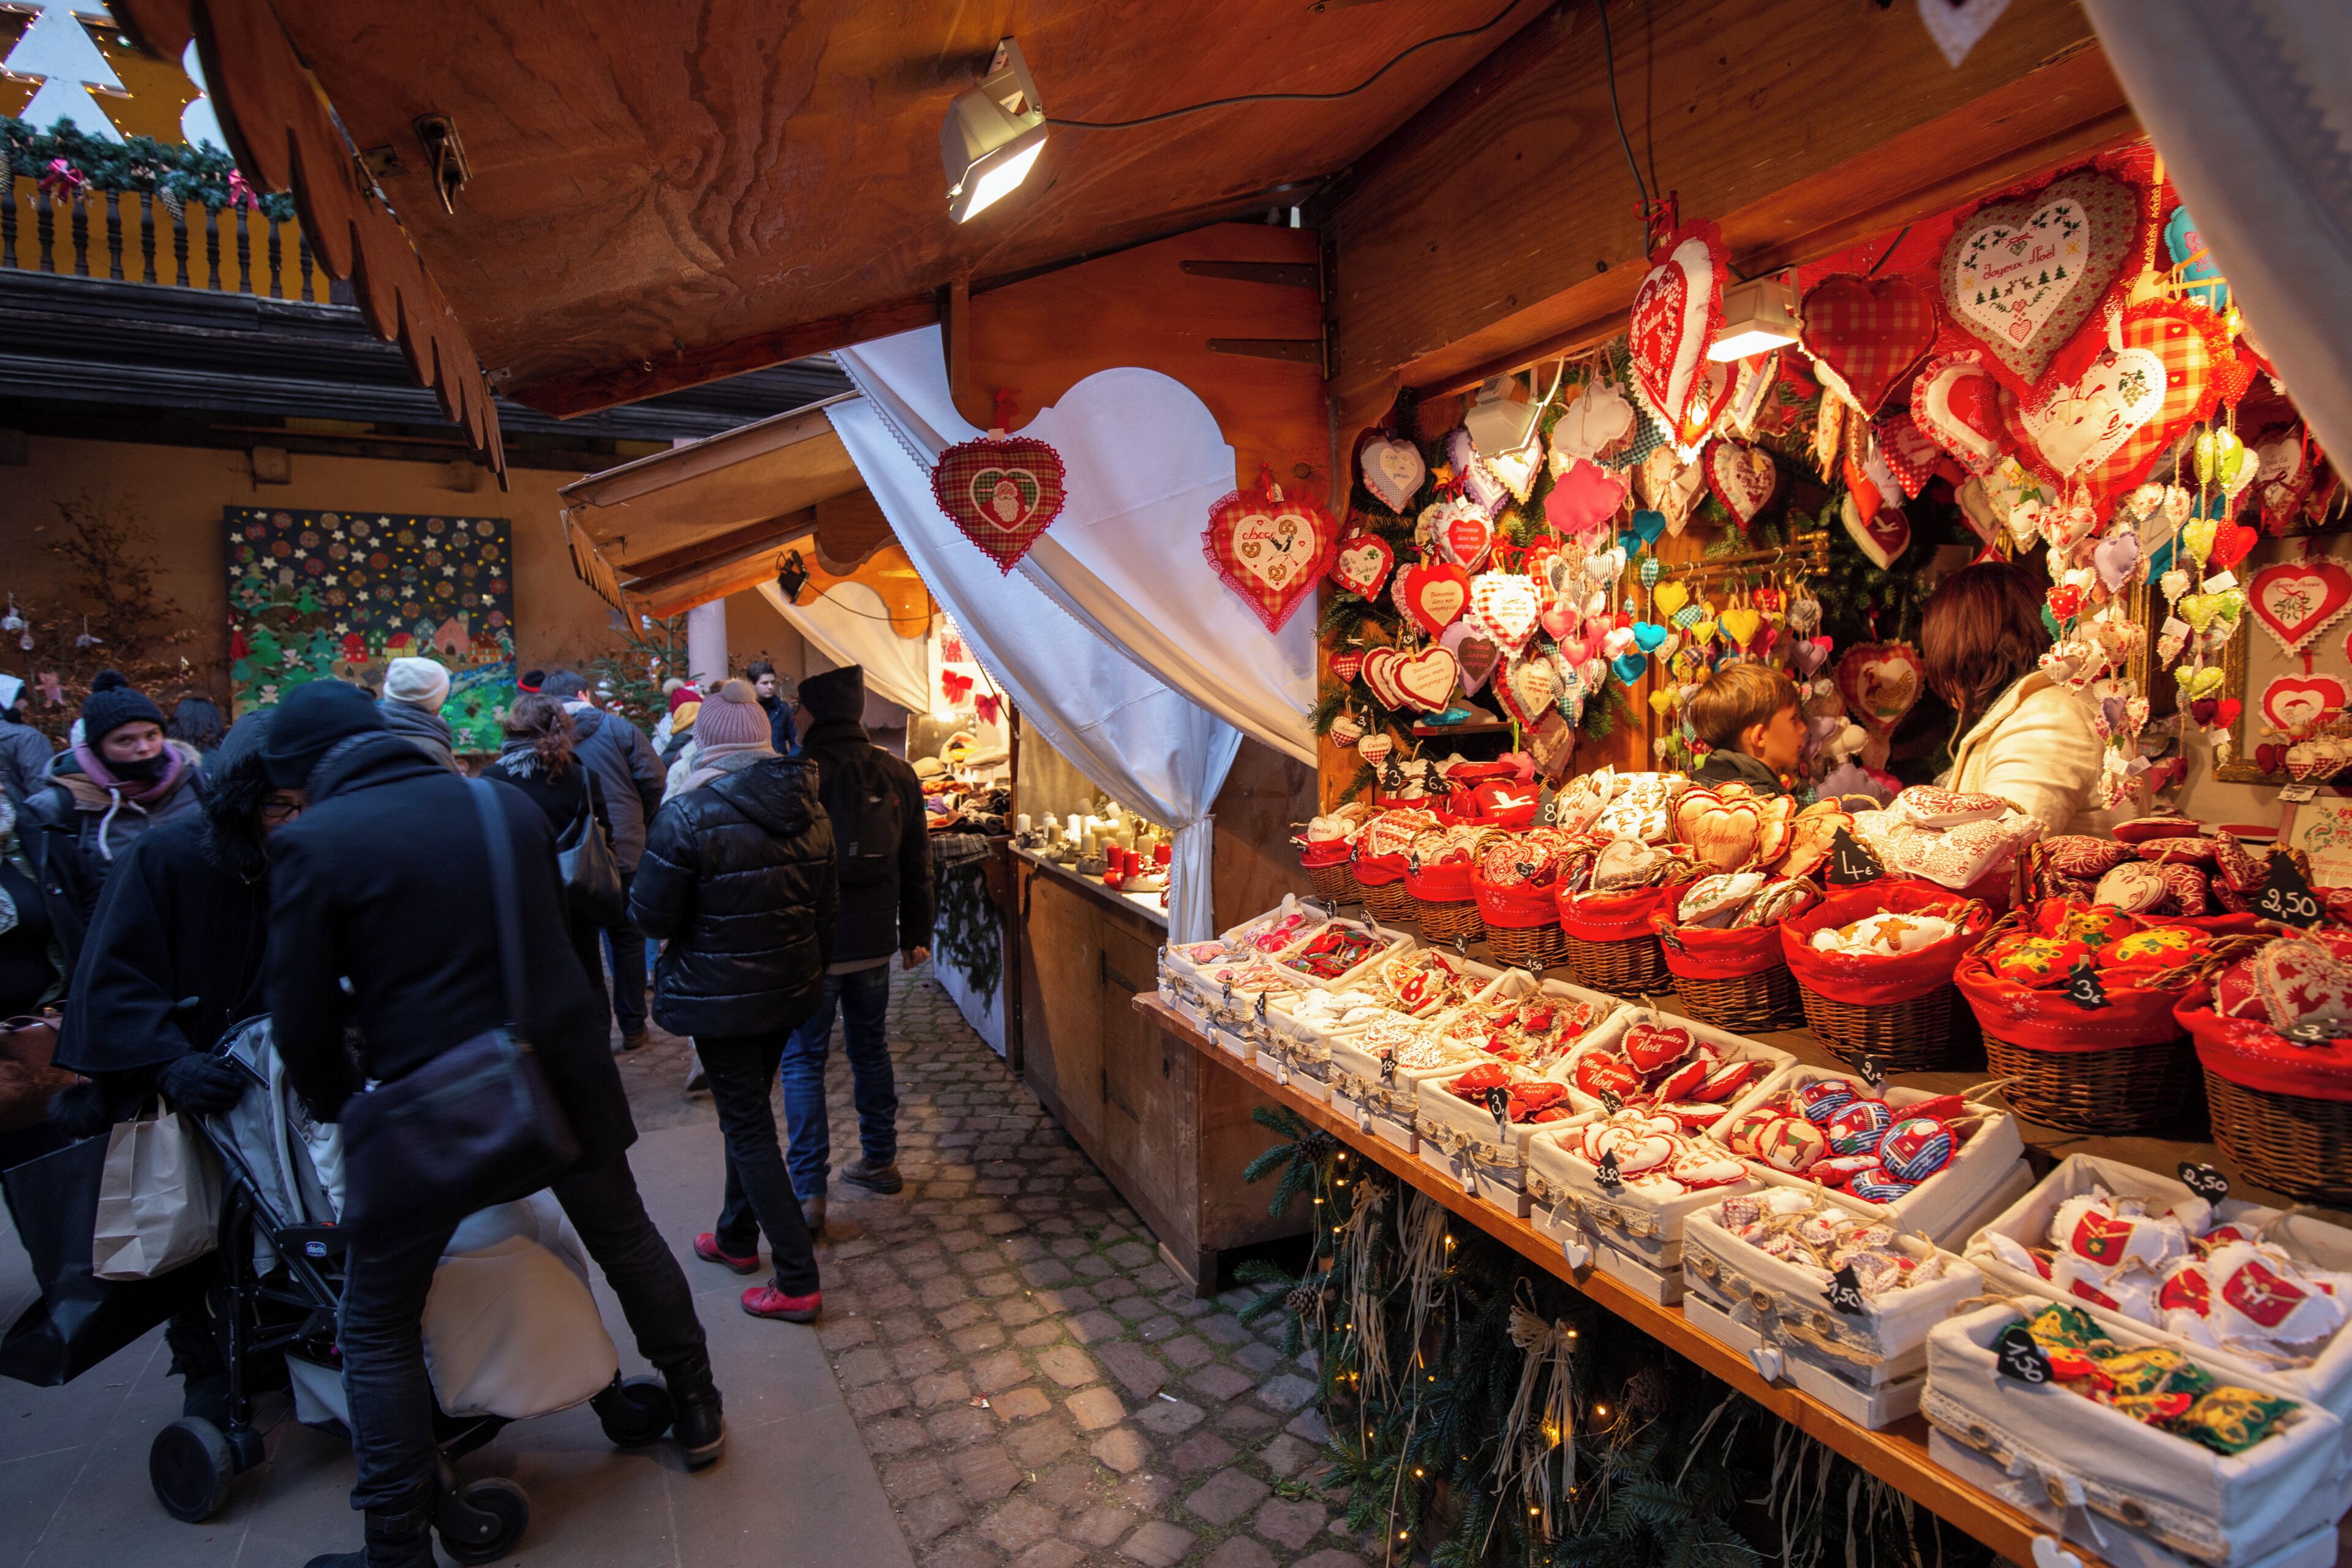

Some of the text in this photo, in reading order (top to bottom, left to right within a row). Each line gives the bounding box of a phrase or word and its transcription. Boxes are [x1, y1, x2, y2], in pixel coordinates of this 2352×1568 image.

[1983, 244, 2055, 280] Joyeux Noël
[1412, 660, 1443, 674] Bienvenue
[1415, 674, 1452, 692] camping-car
[1428, 776, 1444, 792] 6€
[1544, 803, 1557, 822] 8
[1695, 828, 1743, 848] Bonheur
[1520, 865, 1534, 875] 5€
[1842, 850, 1874, 880] 4€
[2261, 888, 2317, 919] 2,50
[1456, 938, 1466, 954] 2€
[1526, 959, 1543, 972] 1,50
[2074, 979, 2101, 1003] 3€
[1629, 1028, 1684, 1045] Mon premier
[1636, 1038, 1663, 1053] Noël
[1580, 1057, 1637, 1085] Mon premier
[1587, 1070, 1615, 1090] Noël
[1861, 1061, 1882, 1081] 2€
[1491, 1094, 1505, 1114] 3€
[1623, 1112, 1653, 1128] Joyeux
[1614, 1131, 1647, 1147] Joyeux
[2184, 1168, 2228, 1192] 2,50
[2006, 1340, 2044, 1383] 1,50
